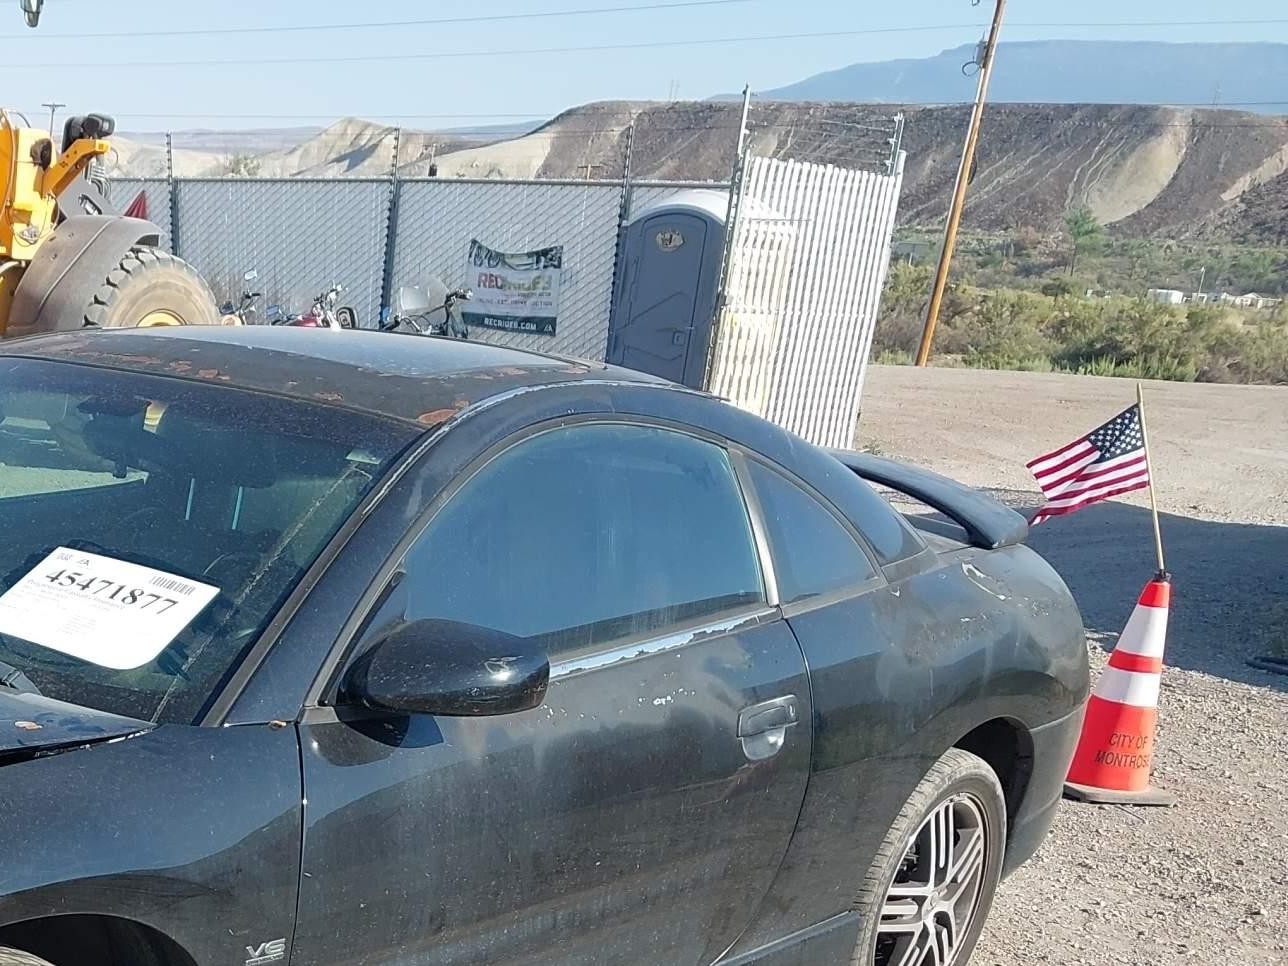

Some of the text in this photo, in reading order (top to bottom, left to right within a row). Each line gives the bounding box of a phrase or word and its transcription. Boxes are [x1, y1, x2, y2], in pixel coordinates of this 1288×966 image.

[45, 569, 179, 615] 45471877
[1108, 733, 1148, 749] CITY OF
[245, 938, 286, 959] V6
